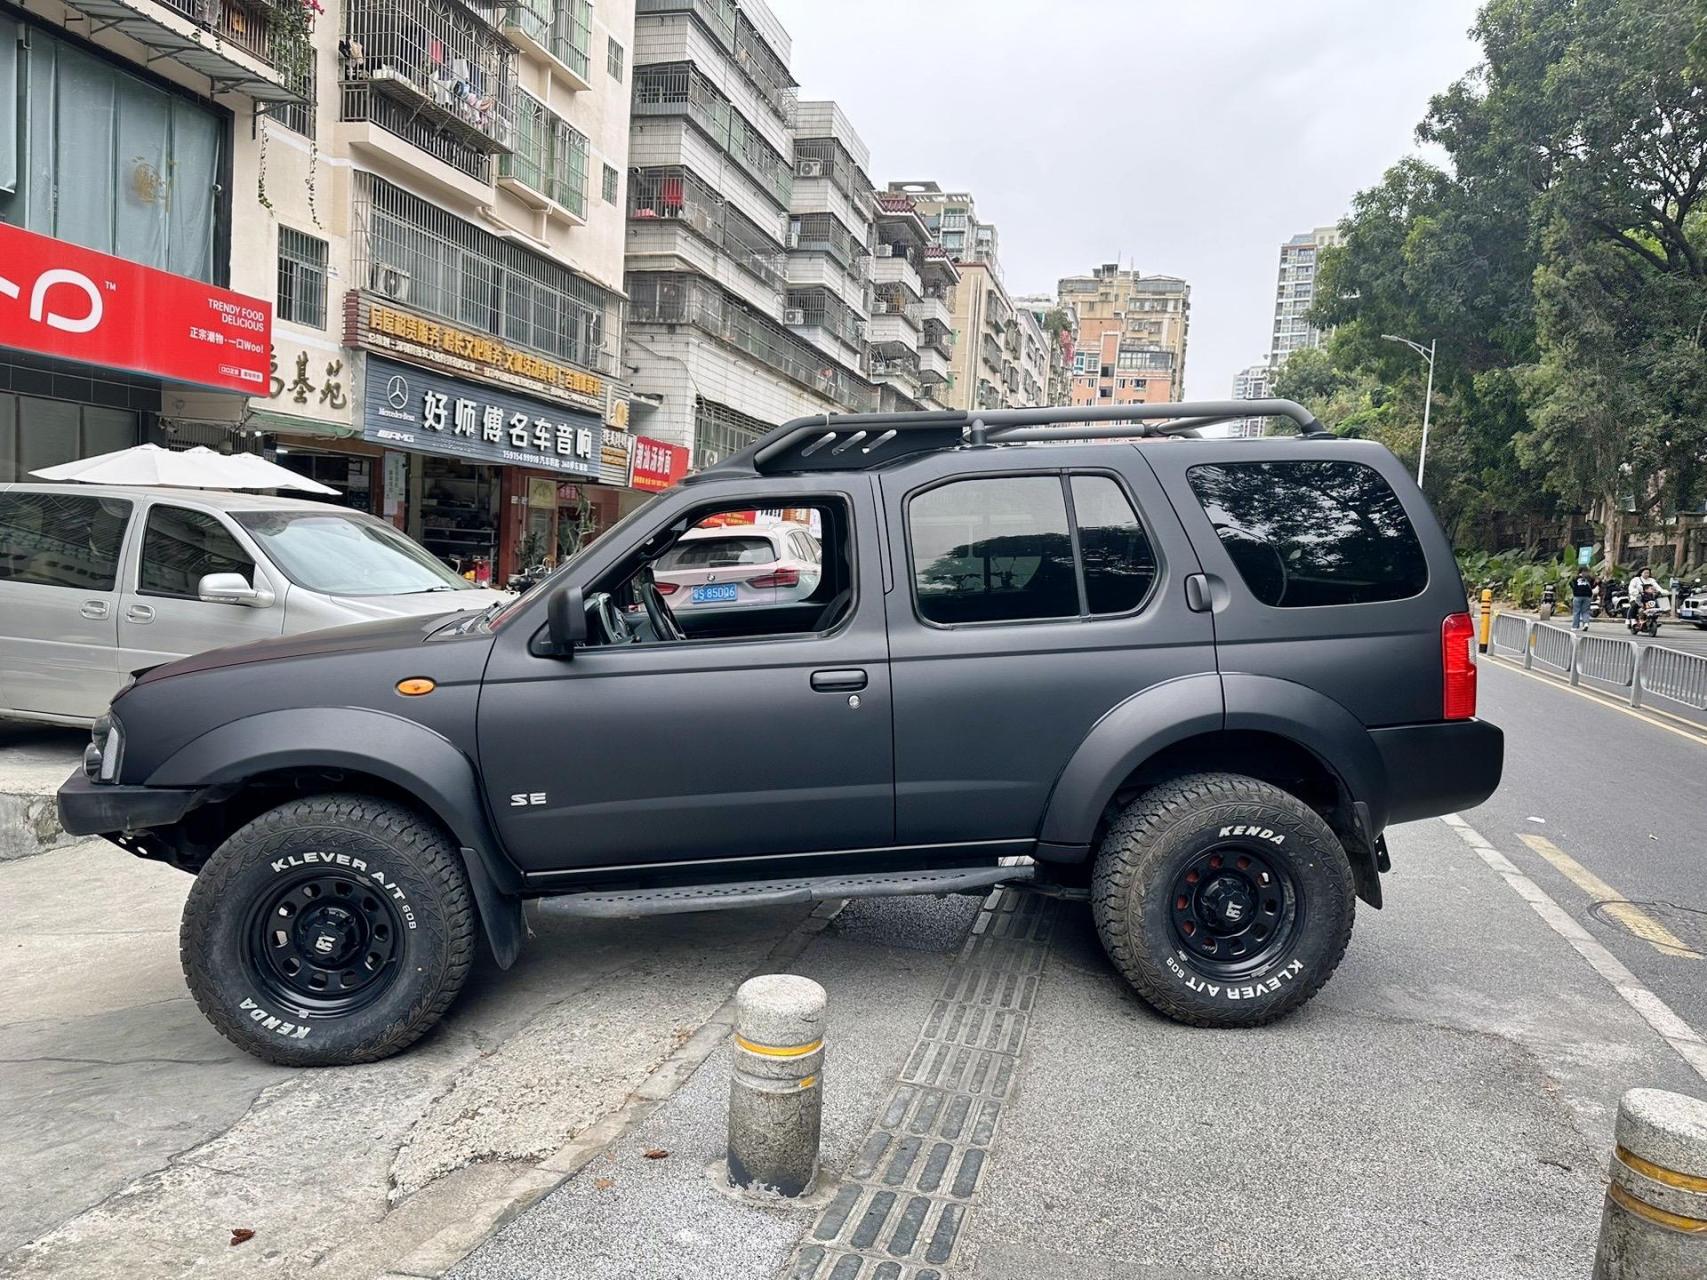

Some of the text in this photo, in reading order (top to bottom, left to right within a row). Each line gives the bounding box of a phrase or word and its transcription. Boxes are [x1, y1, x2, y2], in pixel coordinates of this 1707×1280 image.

[208, 298, 265, 322] TRENDY FOOD
[221, 313, 265, 333] DELICIOUS
[424, 389, 592, 459] 好师傅名车音响
[510, 792, 547, 806] SE
[1218, 825, 1286, 845] KENDA
[270, 851, 368, 873] KLEVER
[370, 871, 406, 901] A/T
[1166, 957, 1304, 1000] KLEVER A/T 608
[239, 996, 311, 1040] KENDA
